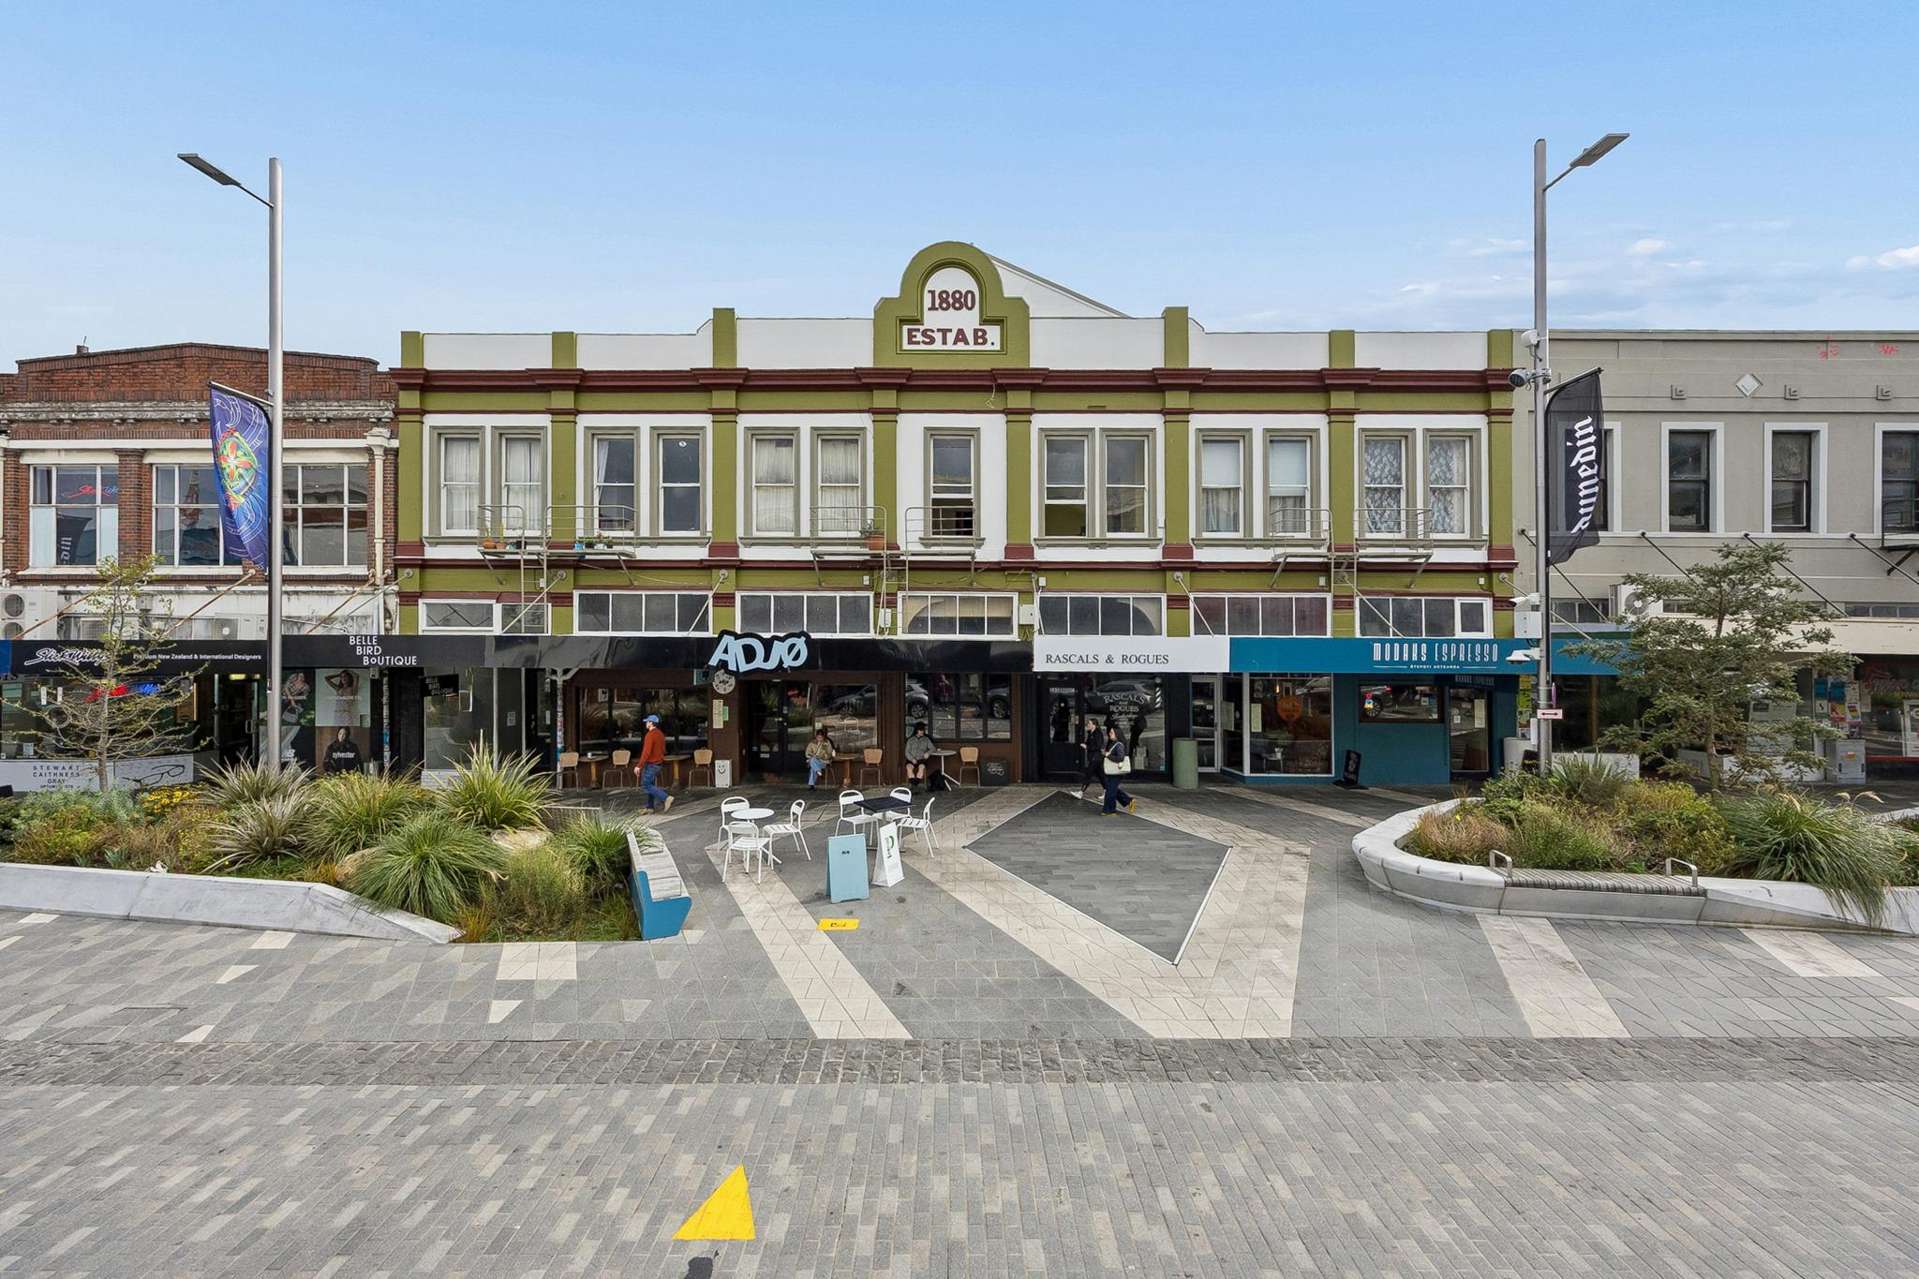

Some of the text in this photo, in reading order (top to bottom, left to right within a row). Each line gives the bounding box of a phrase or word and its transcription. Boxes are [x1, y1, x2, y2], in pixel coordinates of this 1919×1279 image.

[928, 290, 976, 311] 1880
[907, 328, 995, 346] ESTAB.
[349, 635, 378, 645] BELLE
[356, 645, 382, 655] BIRD
[1434, 643, 1499, 662] ESPRESSO
[234, 653, 262, 661] Designers
[1045, 654, 1170, 664] RASCALS & ROGUES
